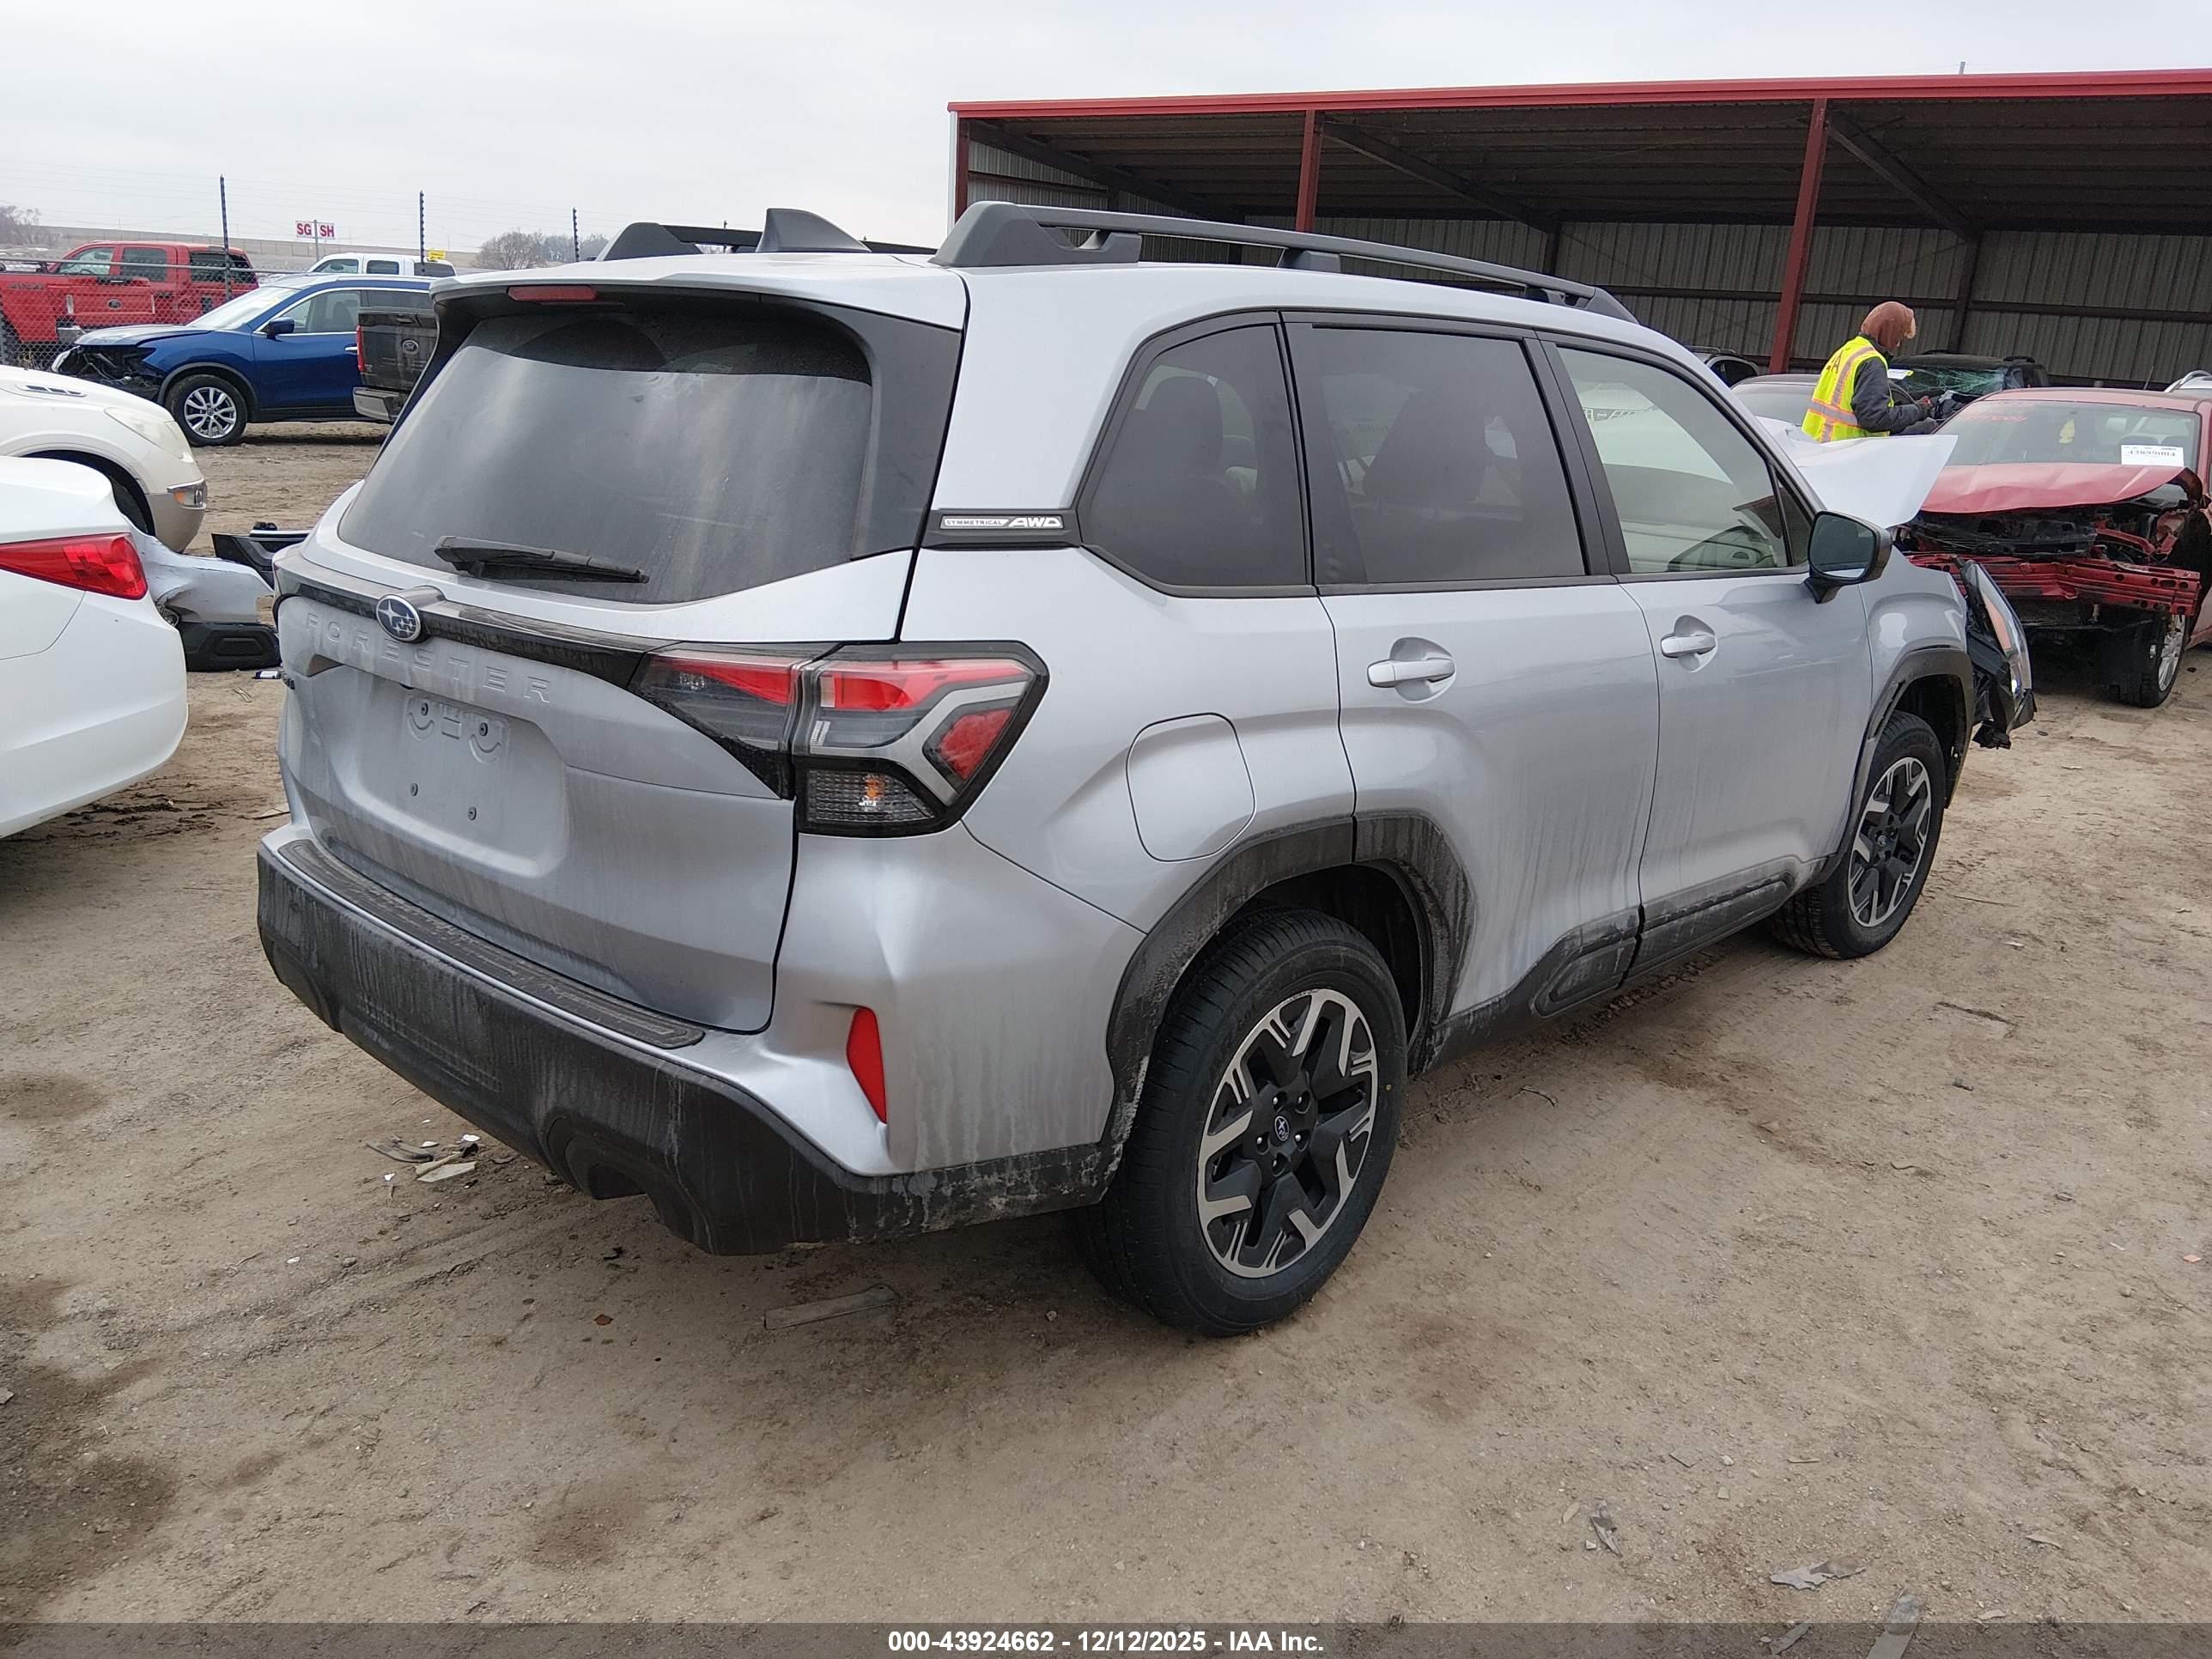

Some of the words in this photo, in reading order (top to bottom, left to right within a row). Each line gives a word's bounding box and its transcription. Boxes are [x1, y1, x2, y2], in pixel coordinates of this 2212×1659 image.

[296, 222, 313, 236] SG
[319, 224, 335, 238] SH
[945, 519, 1004, 527] SYMMETRICAL
[1008, 517, 1062, 528] AWD
[304, 611, 552, 704] FORESTER
